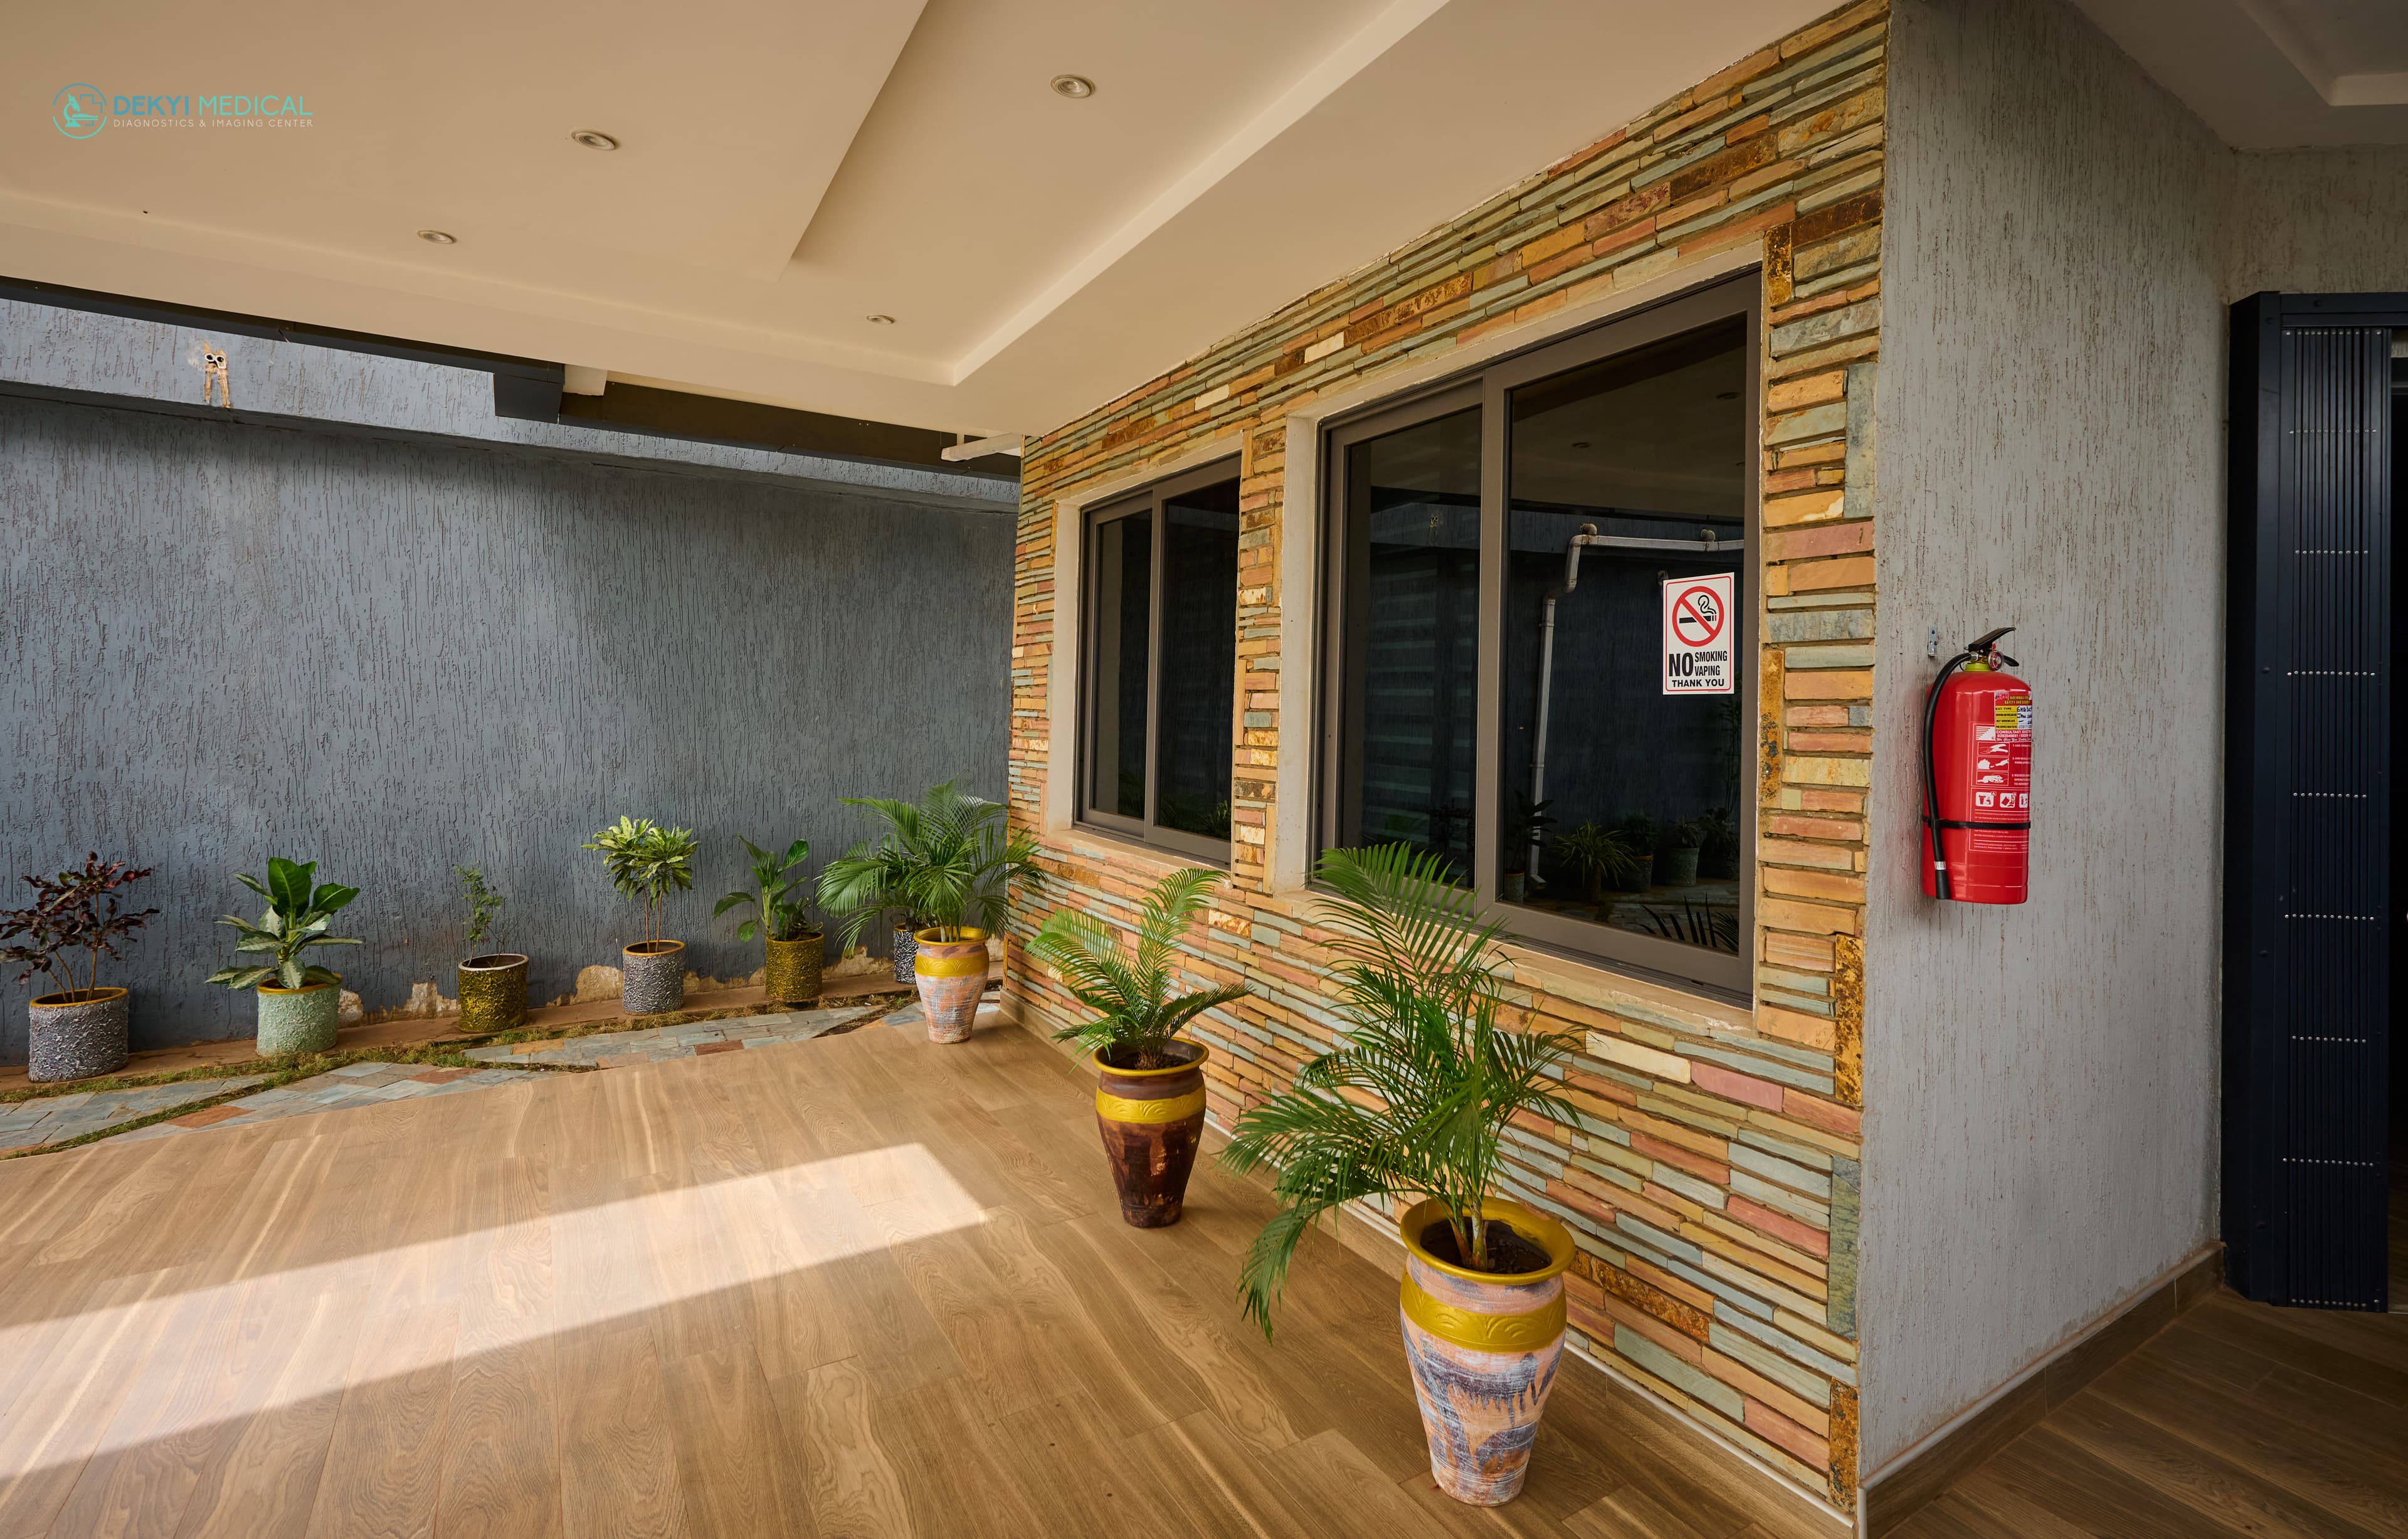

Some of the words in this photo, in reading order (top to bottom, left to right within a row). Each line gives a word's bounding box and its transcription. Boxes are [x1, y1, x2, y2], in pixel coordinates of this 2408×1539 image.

[1669, 653, 1694, 677] NO
[1695, 650, 1728, 662] SMOKING
[1694, 665, 1720, 676] VAPING
[1672, 679, 1703, 687] THANK
[1705, 679, 1724, 687] YOU
